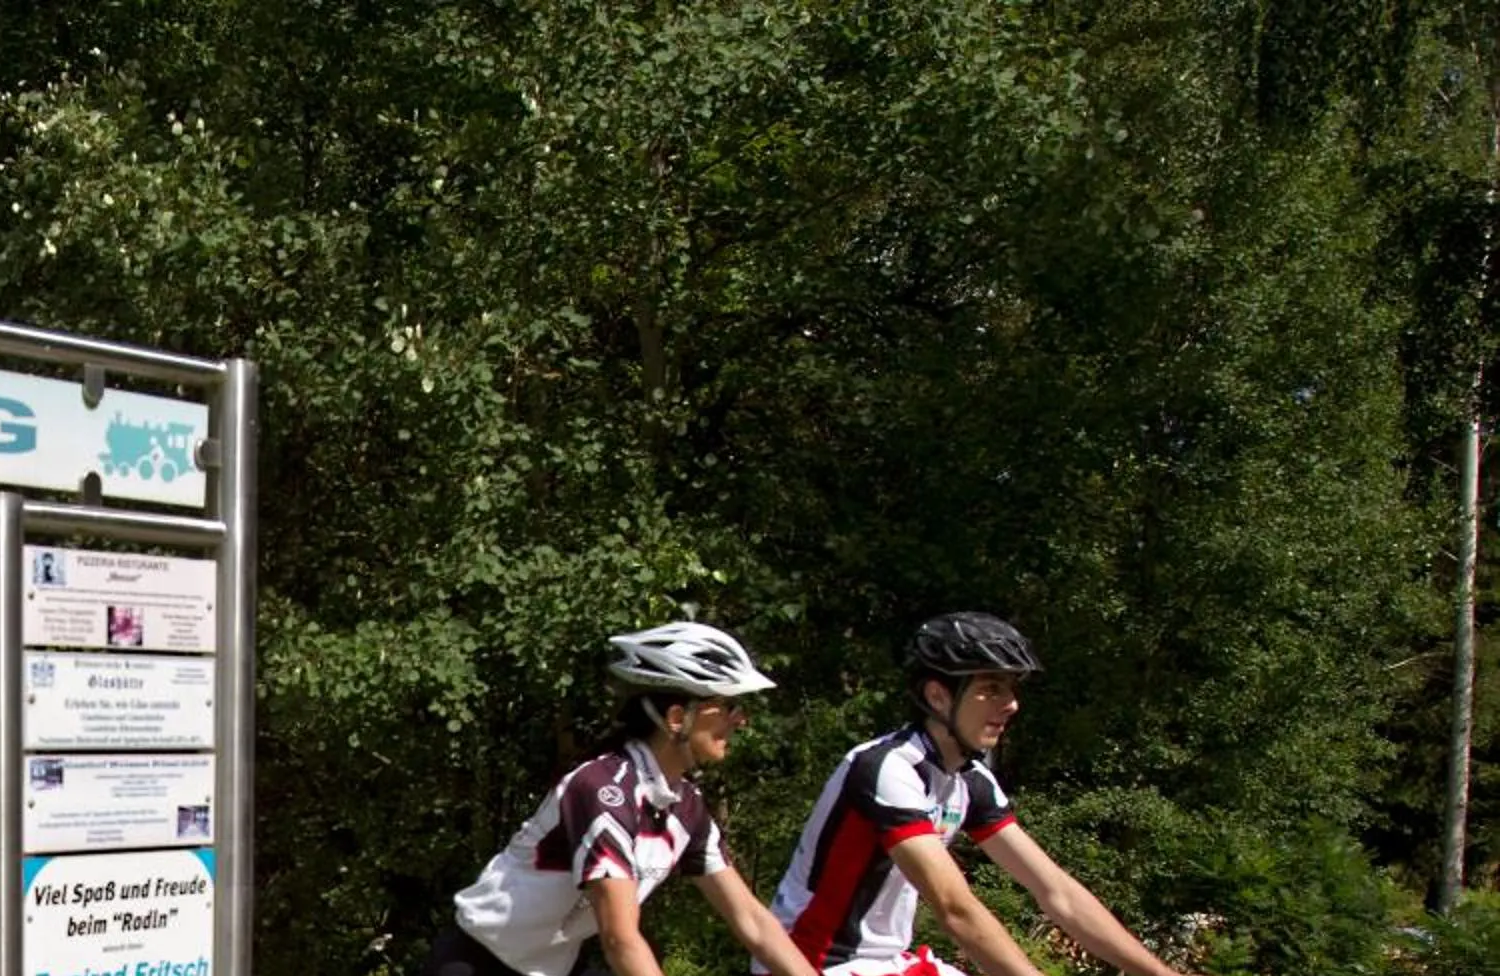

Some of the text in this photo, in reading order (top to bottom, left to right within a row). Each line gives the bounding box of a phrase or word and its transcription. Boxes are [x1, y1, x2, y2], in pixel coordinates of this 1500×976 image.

[35, 876, 207, 908] Viel Spaß und Freude
[67, 913, 107, 937] beim
